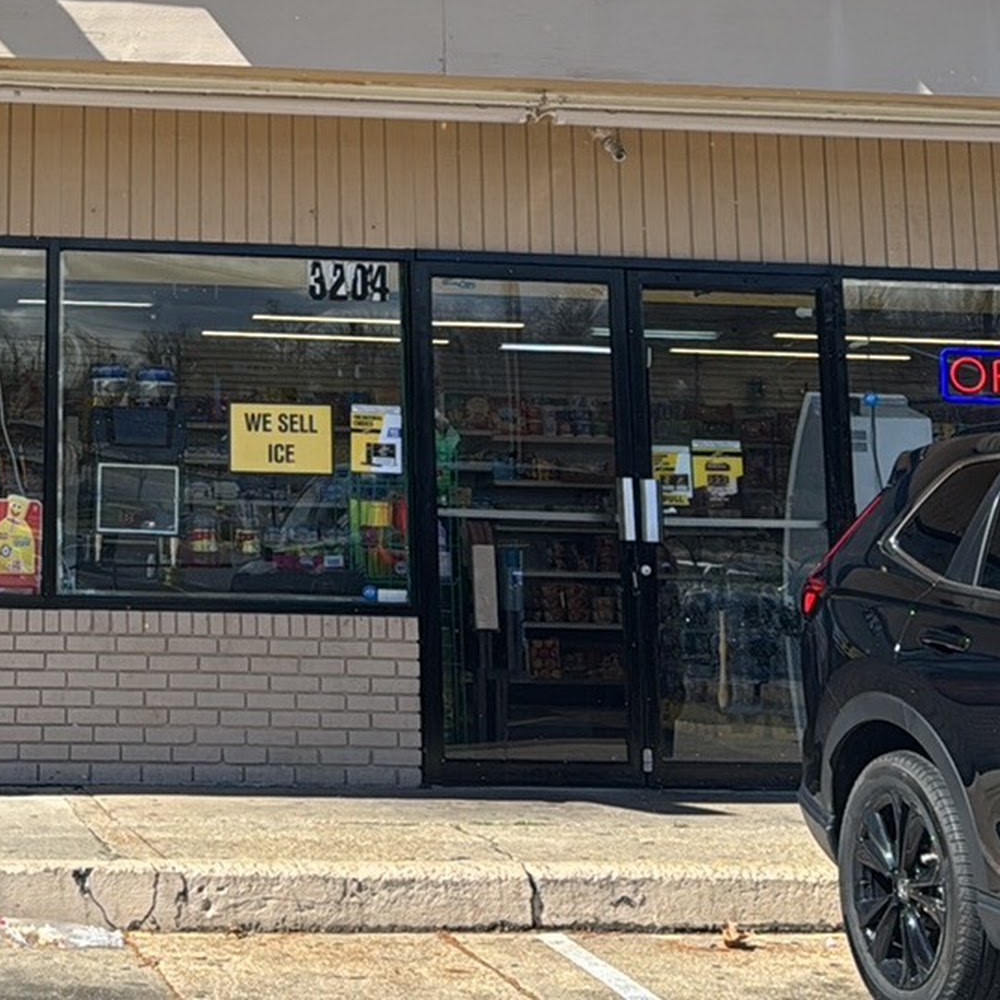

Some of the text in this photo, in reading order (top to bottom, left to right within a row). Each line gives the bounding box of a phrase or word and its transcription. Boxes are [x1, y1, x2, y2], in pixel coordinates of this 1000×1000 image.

[309, 262, 390, 302] 3204
[244, 412, 318, 434] WE SELL
[268, 444, 295, 464] ICE
